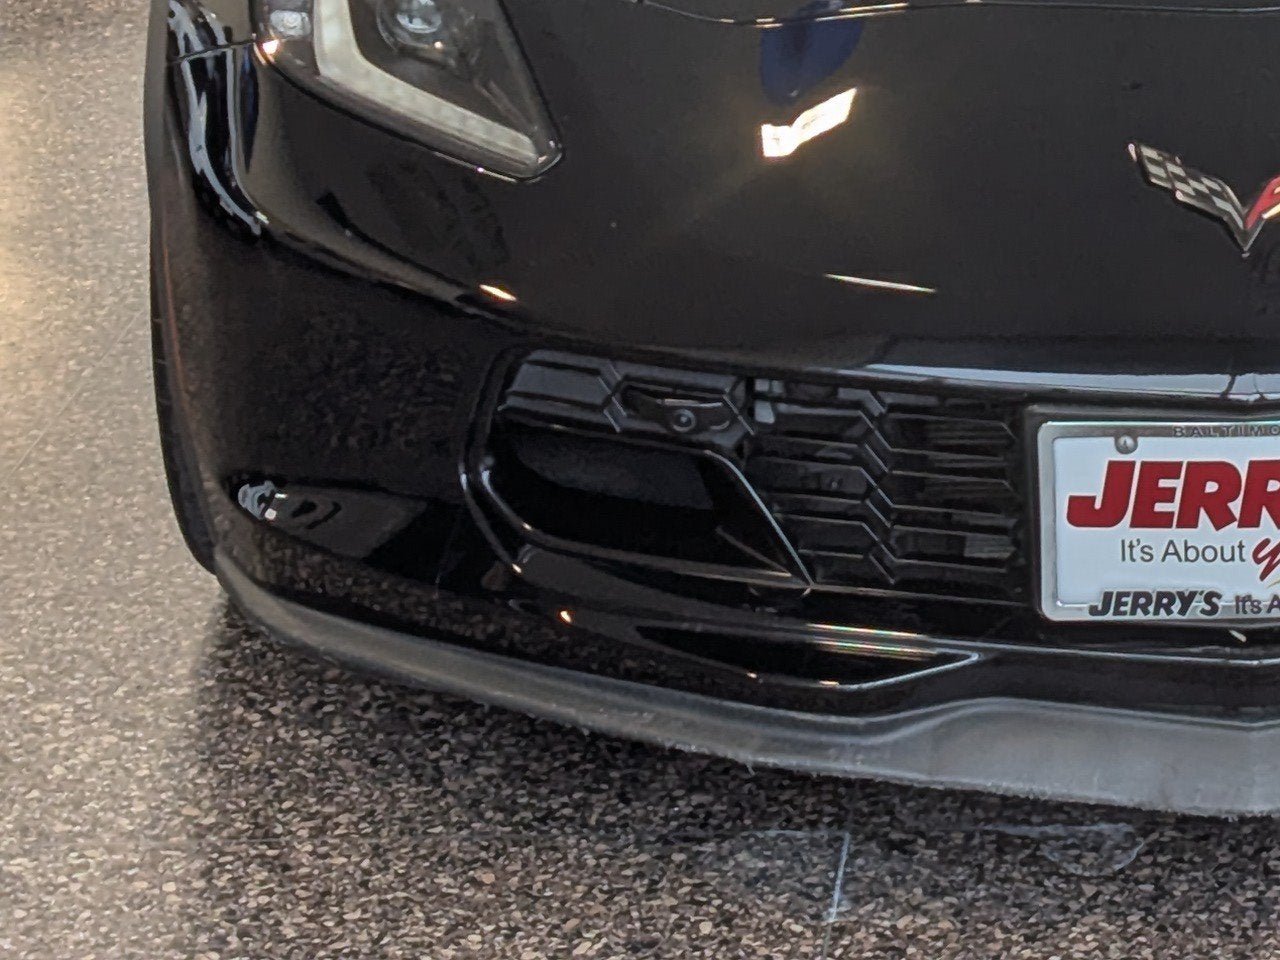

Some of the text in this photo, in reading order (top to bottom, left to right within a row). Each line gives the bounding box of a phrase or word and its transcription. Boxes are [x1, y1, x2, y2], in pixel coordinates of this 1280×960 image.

[1120, 538, 1154, 563] It's
[1161, 539, 1246, 563] About
[1088, 590, 1222, 617] JERRY'S
[1235, 594, 1262, 614] It's
